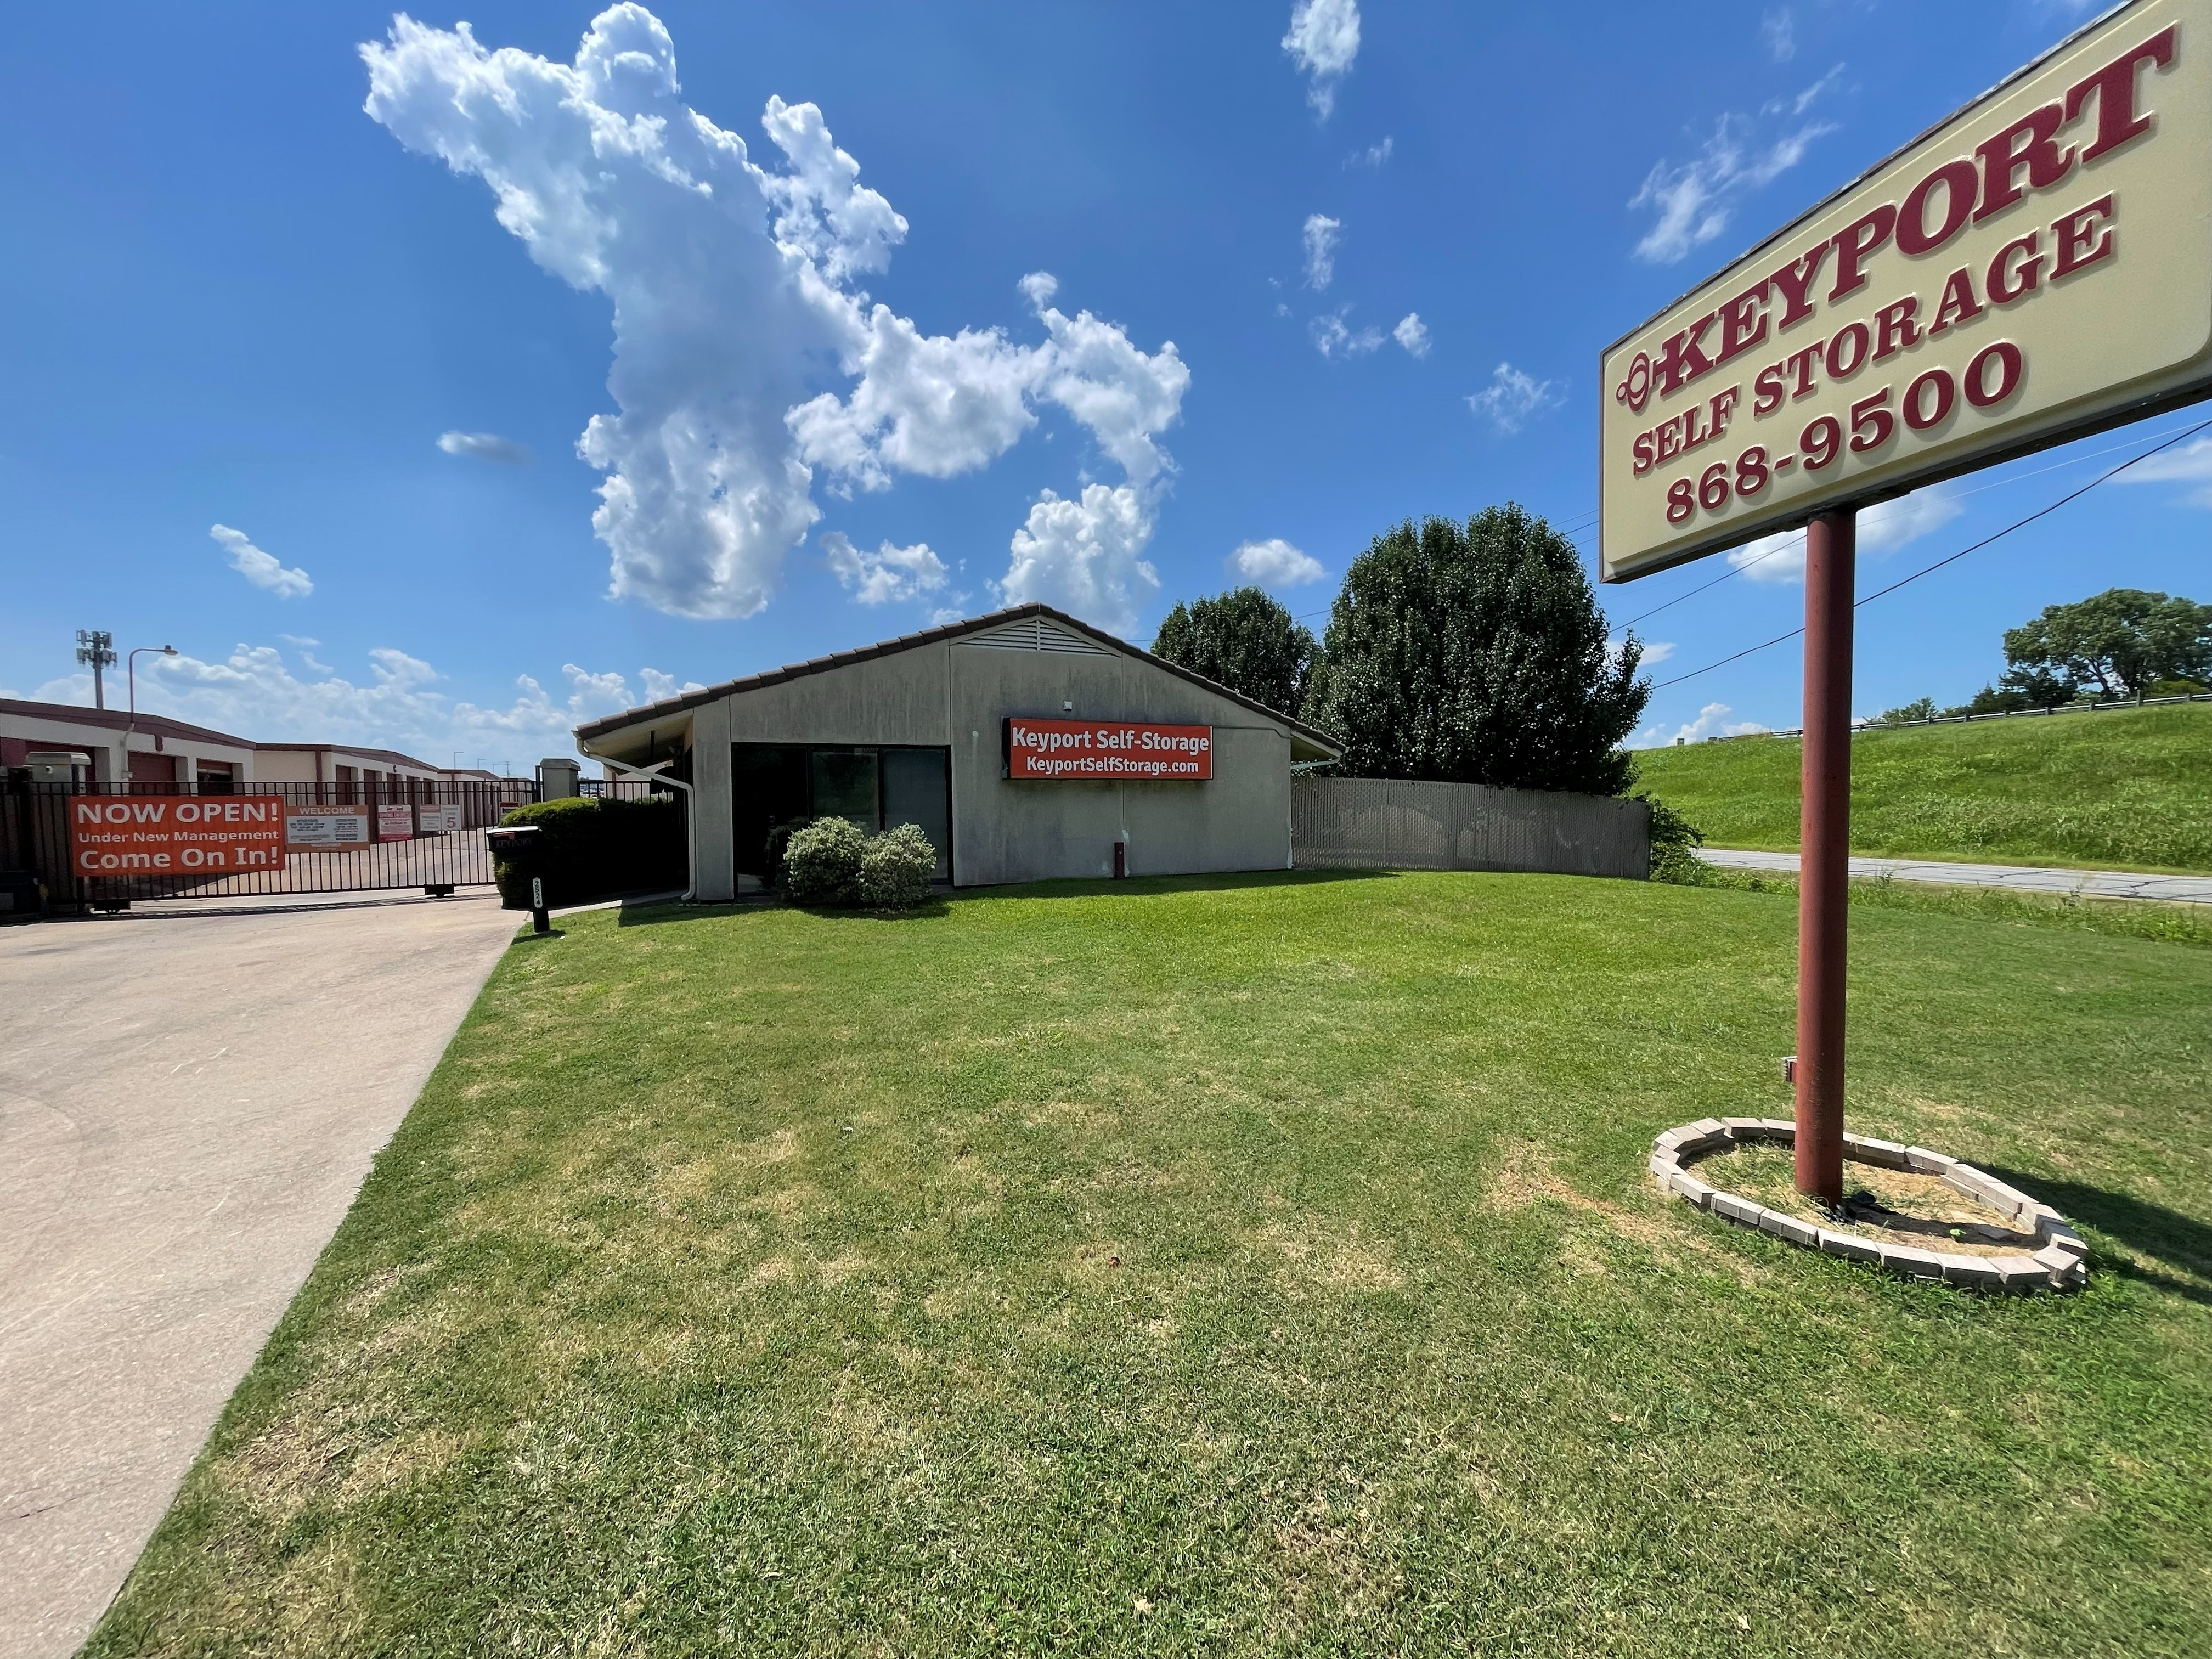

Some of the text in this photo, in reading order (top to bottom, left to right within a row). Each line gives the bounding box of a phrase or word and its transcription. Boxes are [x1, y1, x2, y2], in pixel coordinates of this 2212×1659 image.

[1653, 29, 2174, 397] KEYPORT
[1633, 196, 2112, 474] SELF STORAGE
[1666, 343, 2022, 523] 868-9500
[1012, 727, 1209, 755] Keyport Self-Storage
[1026, 755, 1199, 776] KeyportSelfStorage.com
[77, 803, 278, 824] NOW OPEN!
[299, 806, 356, 815] WELCOME
[447, 816, 456, 828] 5
[78, 830, 279, 843] Under New Management
[80, 846, 278, 870] Come On In!
